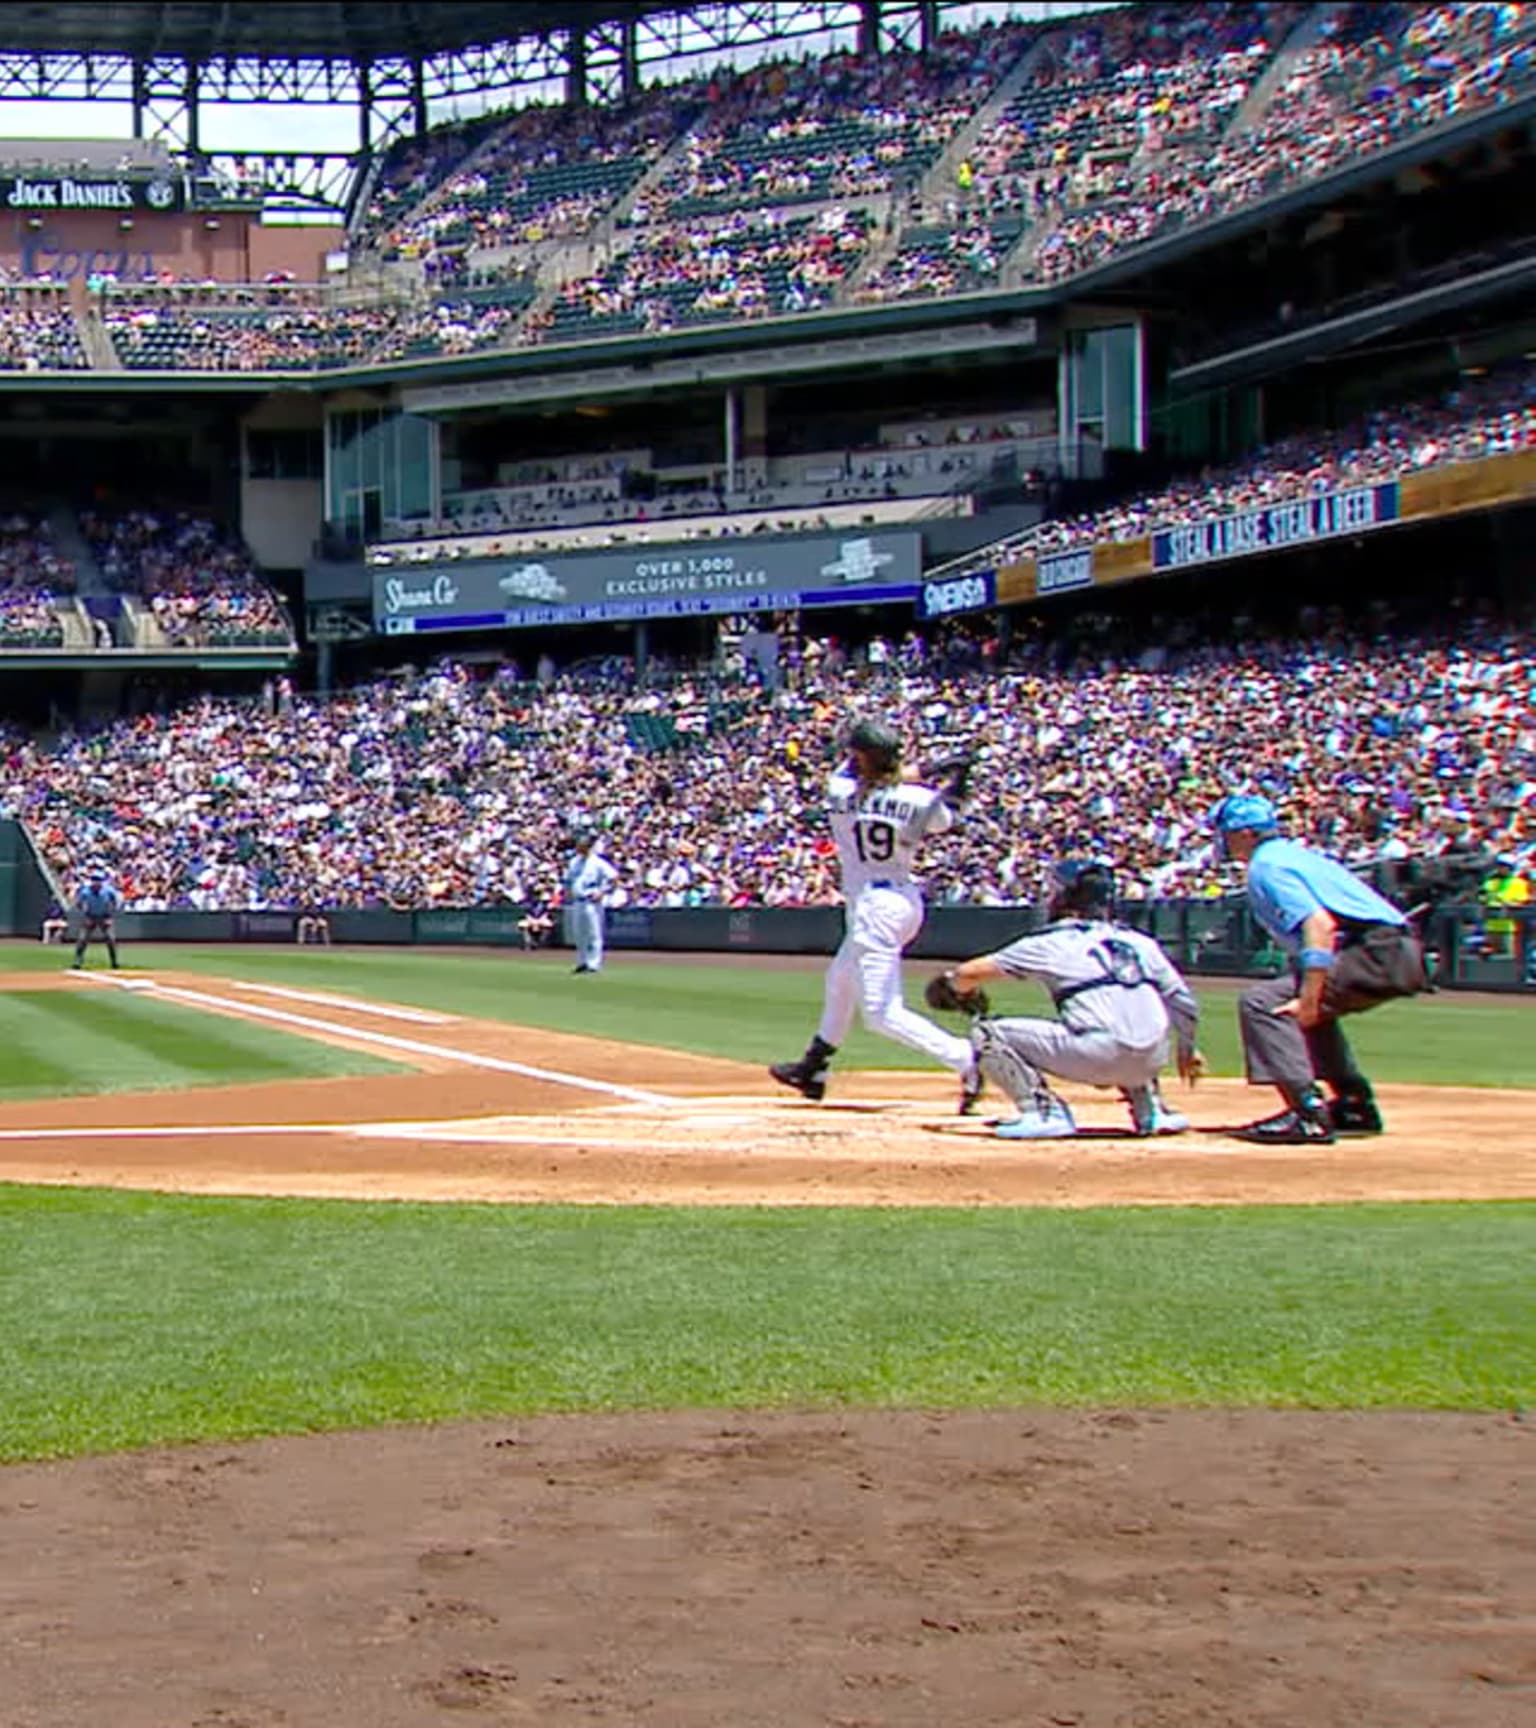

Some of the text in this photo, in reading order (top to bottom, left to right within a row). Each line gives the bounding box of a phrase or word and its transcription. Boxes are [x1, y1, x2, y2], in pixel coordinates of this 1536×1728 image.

[8, 175, 58, 206] JACK
[61, 176, 136, 207] DANIEL'S
[635, 557, 734, 578] OVER 1,000
[606, 569, 767, 596] EXCLUSIVE STYLES
[852, 820, 895, 863] 19
